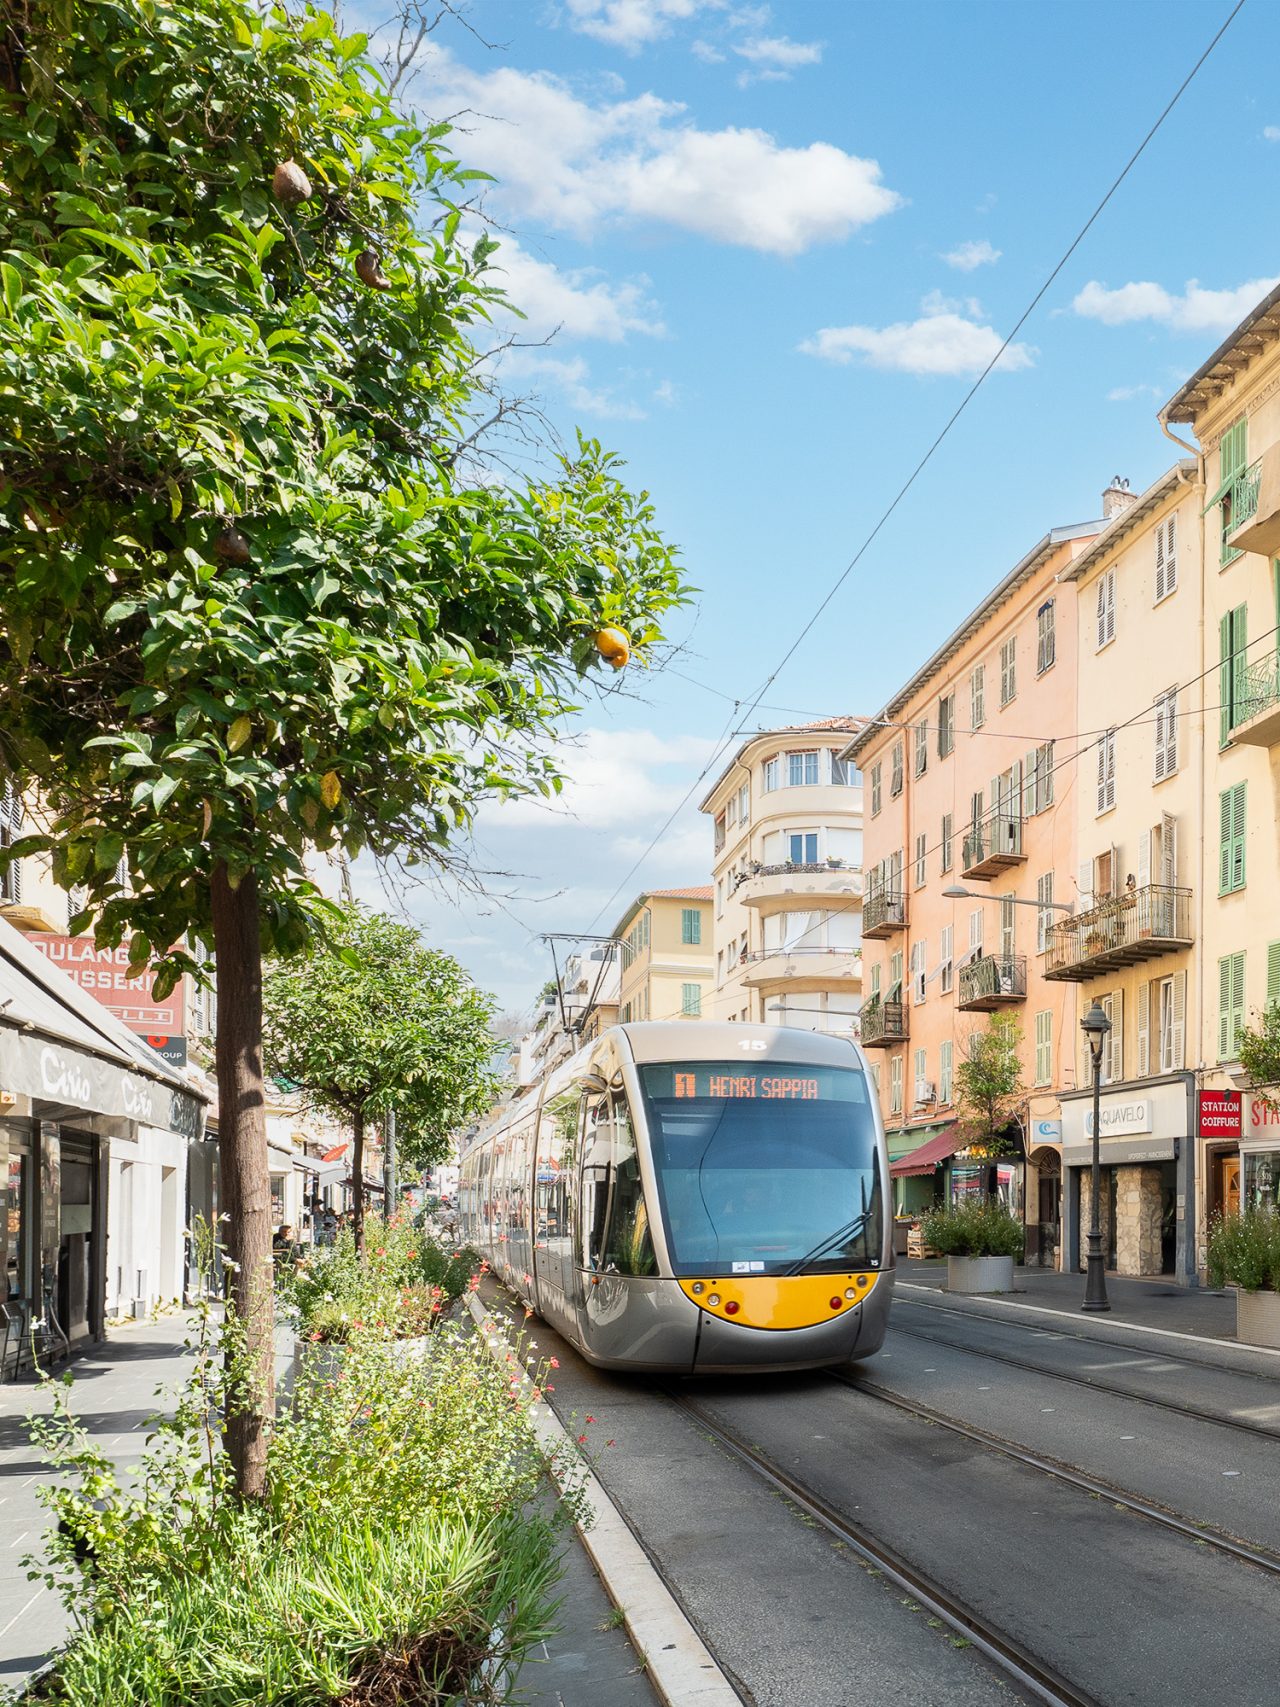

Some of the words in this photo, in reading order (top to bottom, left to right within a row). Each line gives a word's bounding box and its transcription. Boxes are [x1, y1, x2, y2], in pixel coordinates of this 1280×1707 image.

[738, 1039, 768, 1051] 15
[710, 1076, 756, 1098] HENRI
[761, 1078, 817, 1099] SAPPIA
[1202, 1101, 1239, 1112] STATION
[1202, 1117, 1239, 1127] COIFFURE
